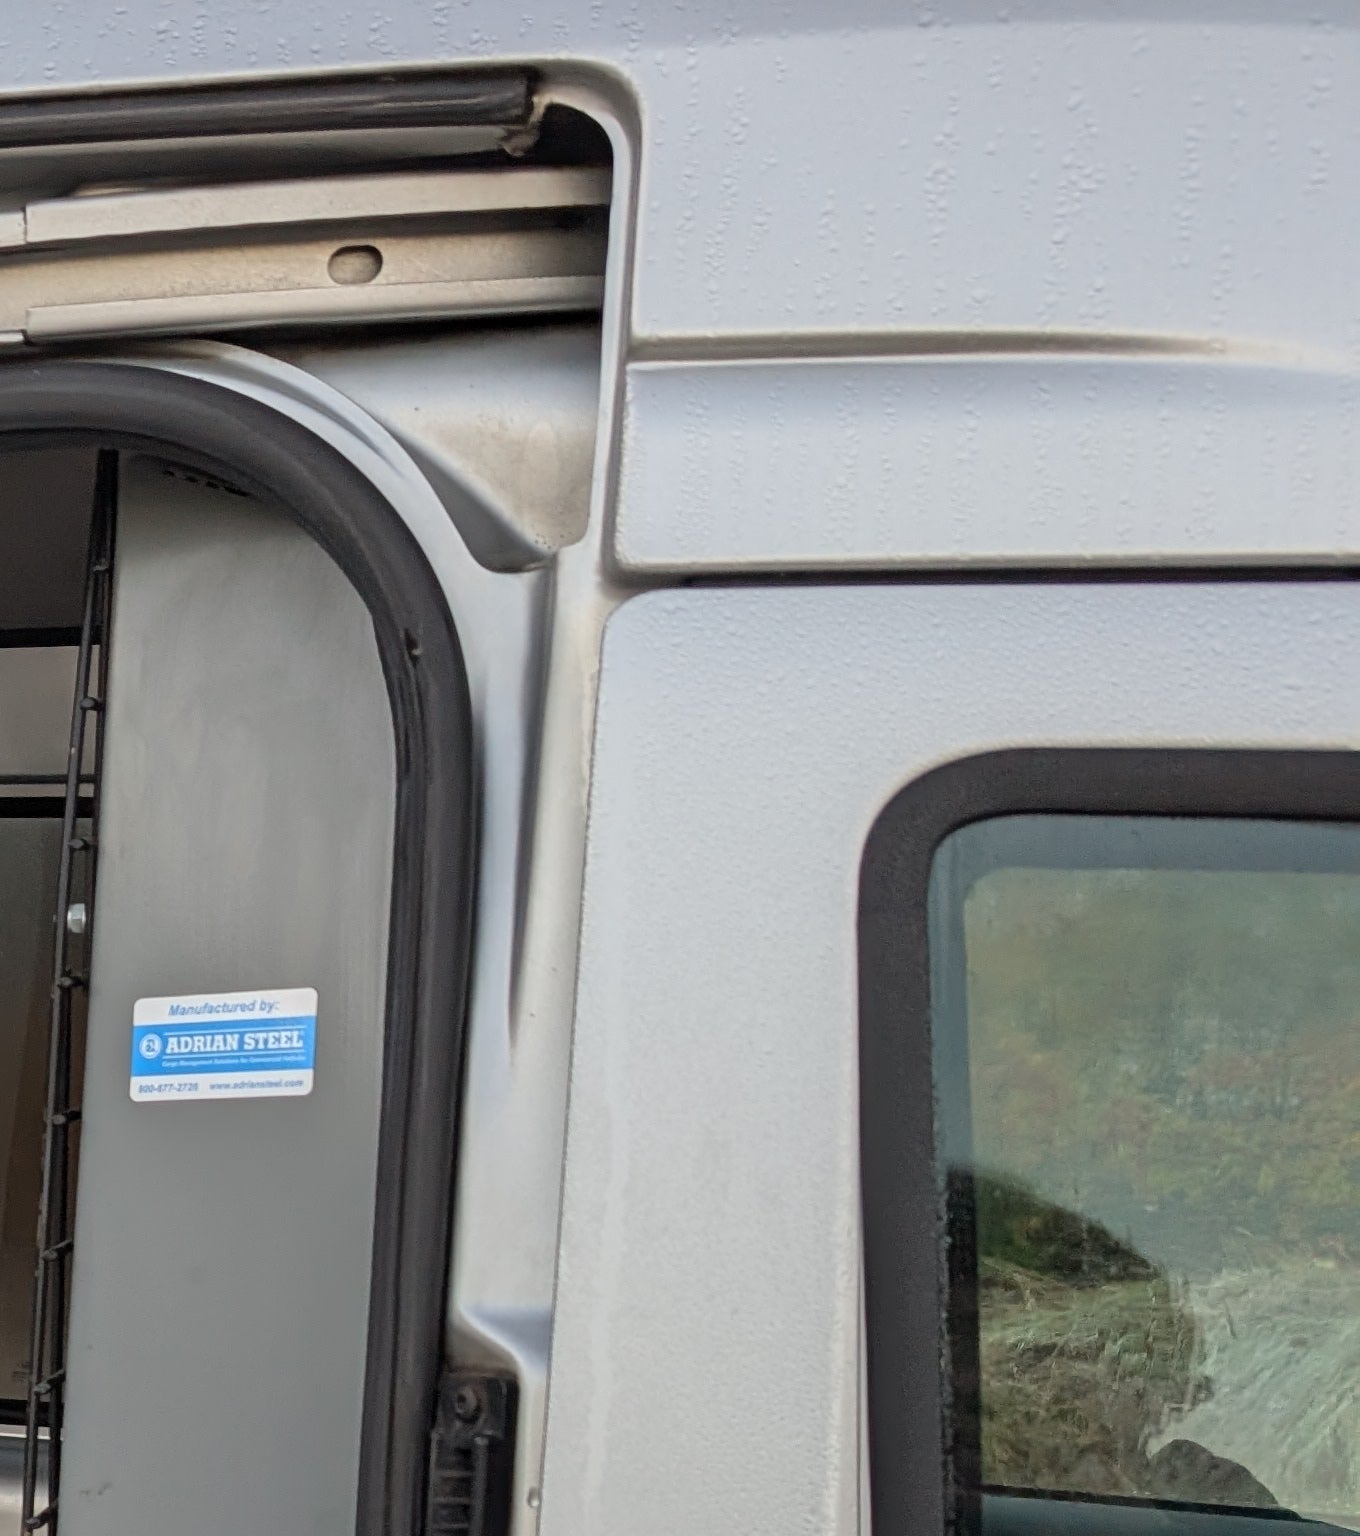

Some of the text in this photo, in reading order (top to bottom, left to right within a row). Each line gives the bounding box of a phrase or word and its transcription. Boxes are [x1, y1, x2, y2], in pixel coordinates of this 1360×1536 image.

[168, 999, 279, 1016] Manufactured by:
[165, 1030, 303, 1054] ADRIAN STEEL
